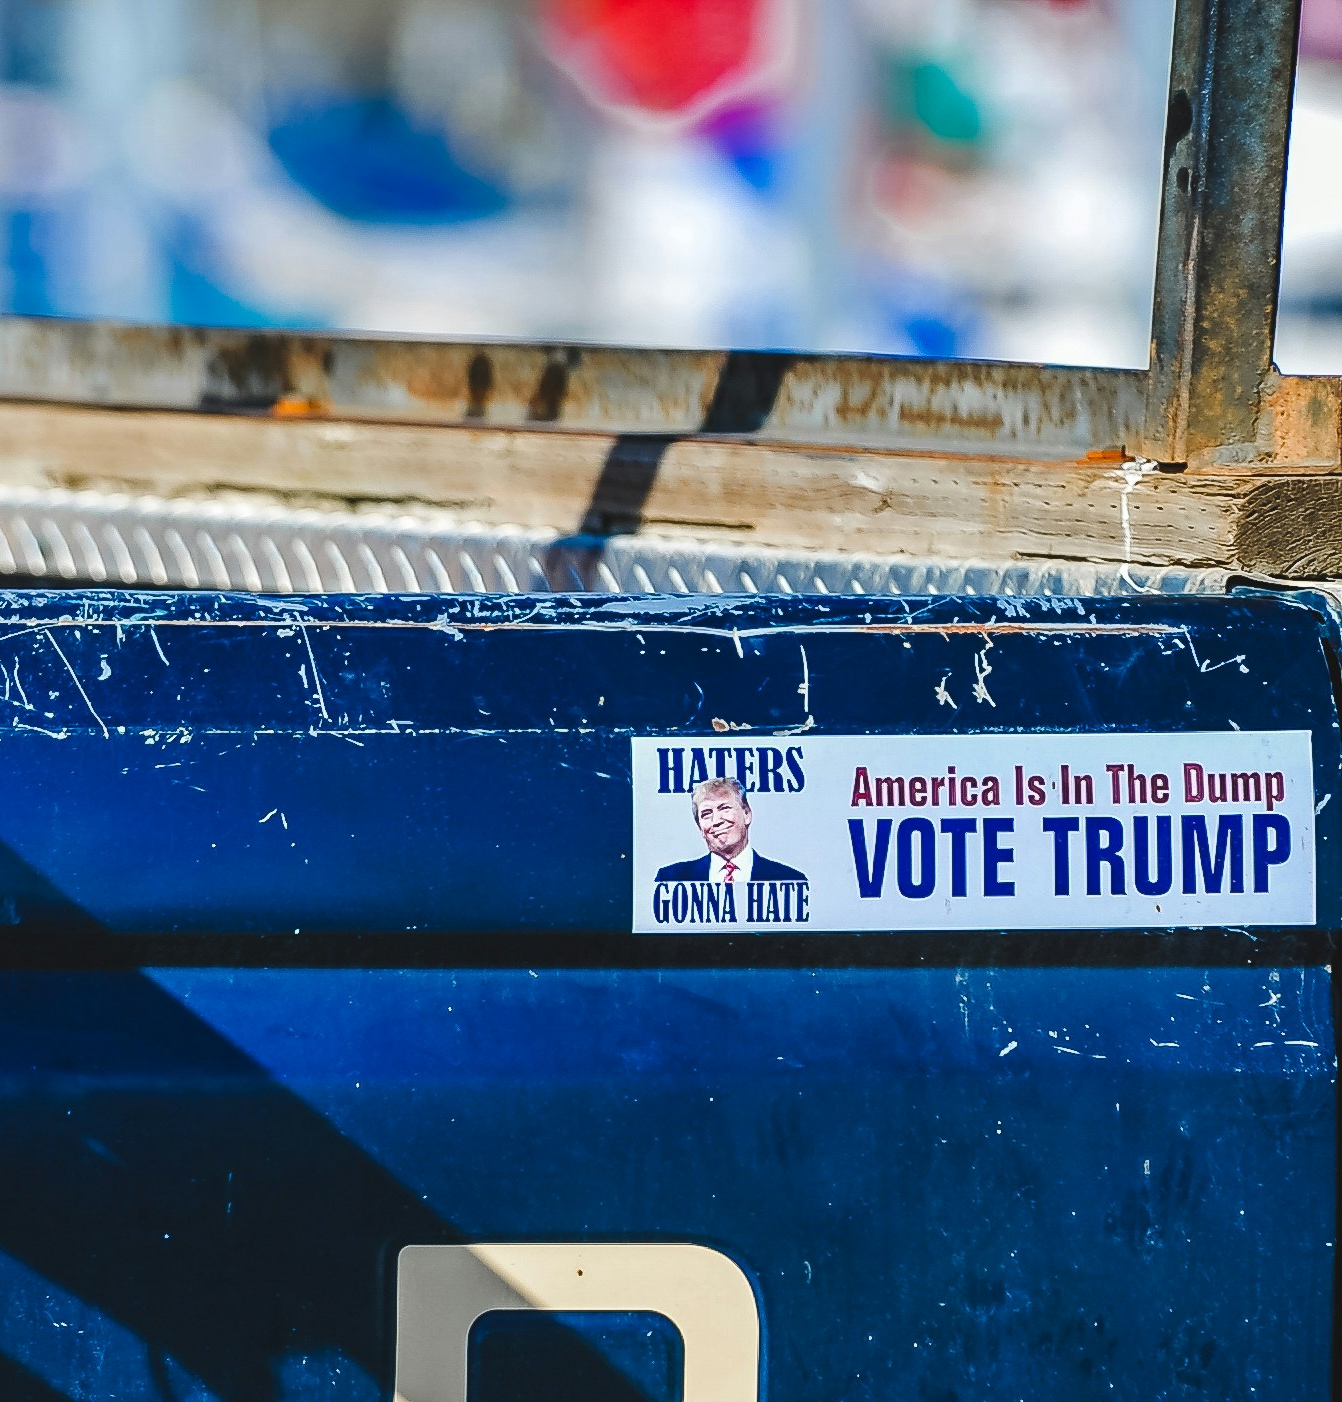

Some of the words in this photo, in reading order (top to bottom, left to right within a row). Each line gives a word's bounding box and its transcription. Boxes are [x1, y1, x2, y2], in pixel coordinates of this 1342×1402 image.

[656, 746, 806, 794] HATERS
[850, 765, 1002, 807] America
[1015, 764, 1046, 806] Is
[1060, 764, 1095, 805] In
[1106, 763, 1170, 804] The
[1183, 763, 1285, 811] Dump
[847, 817, 1015, 898] VOTE
[1042, 813, 1292, 896] TRUMP
[652, 882, 738, 924] GONNA
[746, 881, 810, 923] HATE
